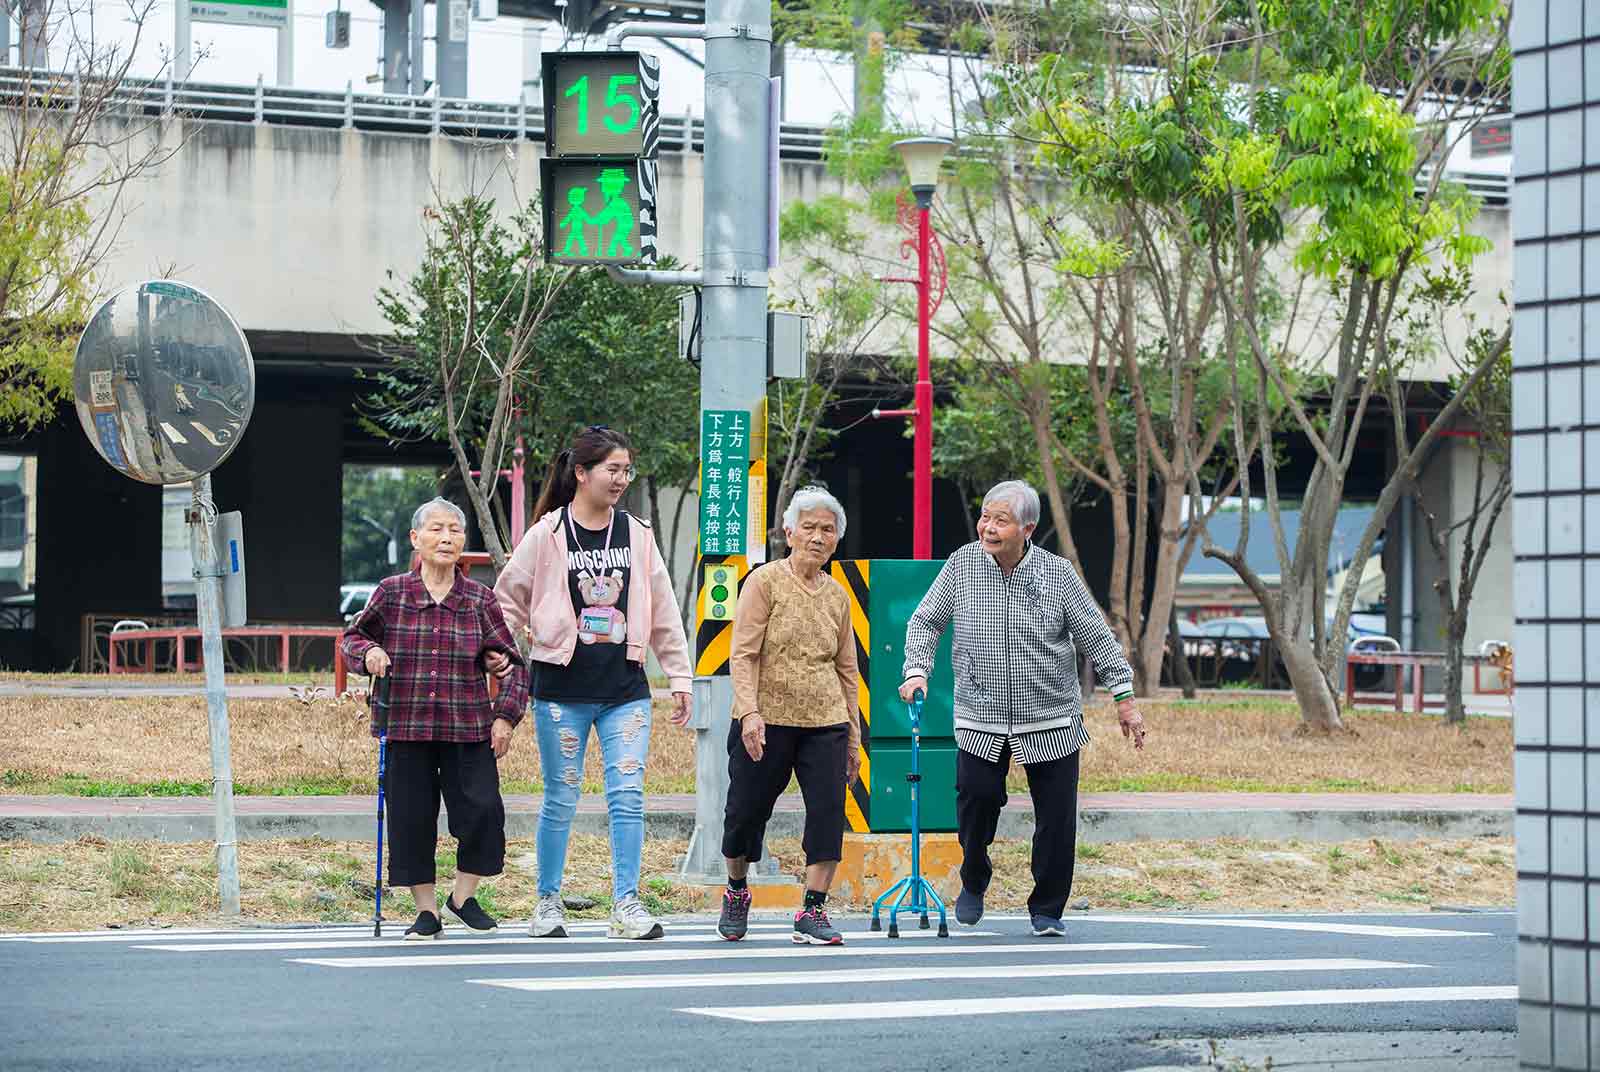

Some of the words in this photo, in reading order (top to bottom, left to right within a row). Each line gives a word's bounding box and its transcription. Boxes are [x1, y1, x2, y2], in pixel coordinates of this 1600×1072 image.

[564, 74, 640, 135] 15
[725, 414, 745, 552] 上方一般行人按鈕
[568, 546, 631, 570] MOSCHINO
